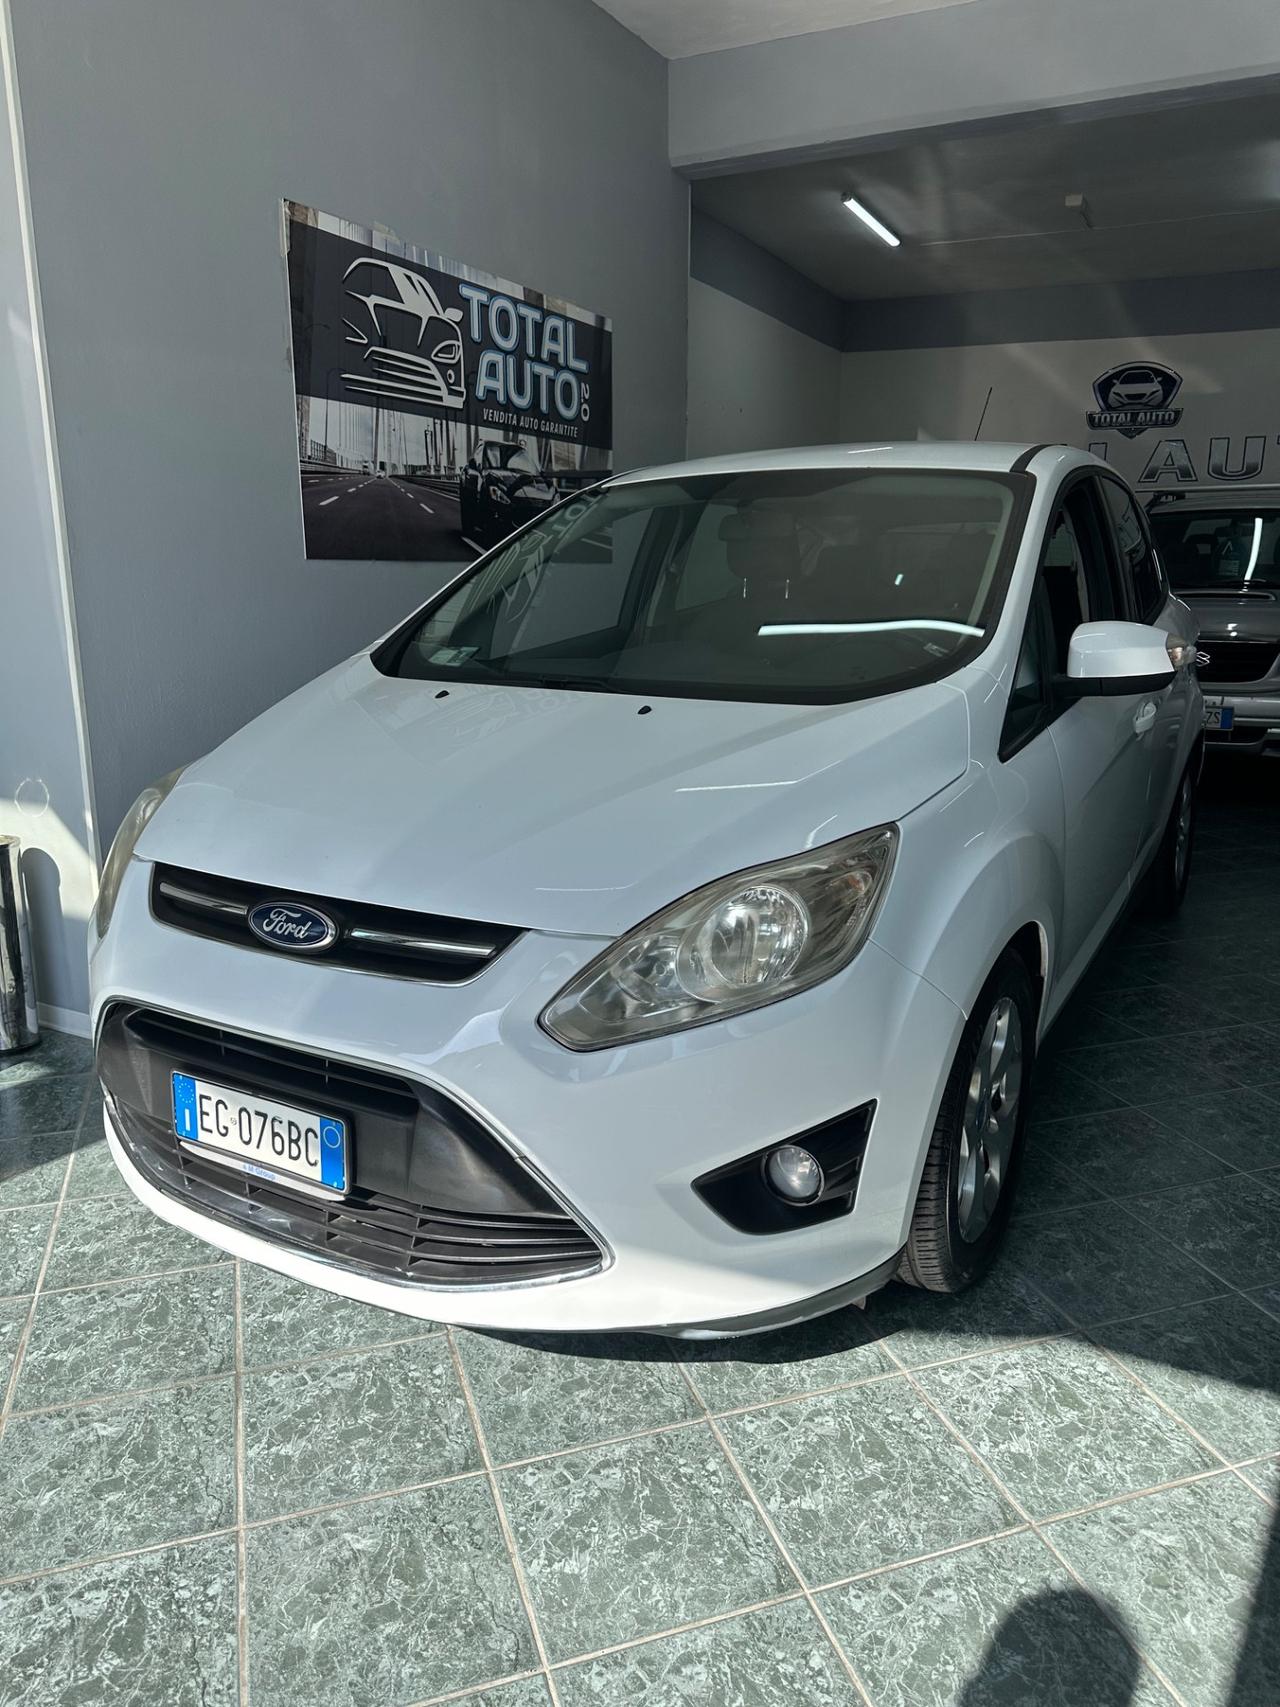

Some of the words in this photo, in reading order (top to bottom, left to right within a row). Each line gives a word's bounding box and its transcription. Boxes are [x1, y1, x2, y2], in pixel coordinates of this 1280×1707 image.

[459, 284, 589, 374] TOTAL
[475, 350, 581, 420] AUTO
[483, 408, 517, 426] VENDITA
[520, 416, 538, 430] AUTO
[541, 420, 578, 438] GARANTITE
[1092, 412, 1133, 426] TOTAL
[1136, 411, 1175, 426] AUTO
[1138, 436, 1280, 483] AU
[262, 908, 313, 939] Ford
